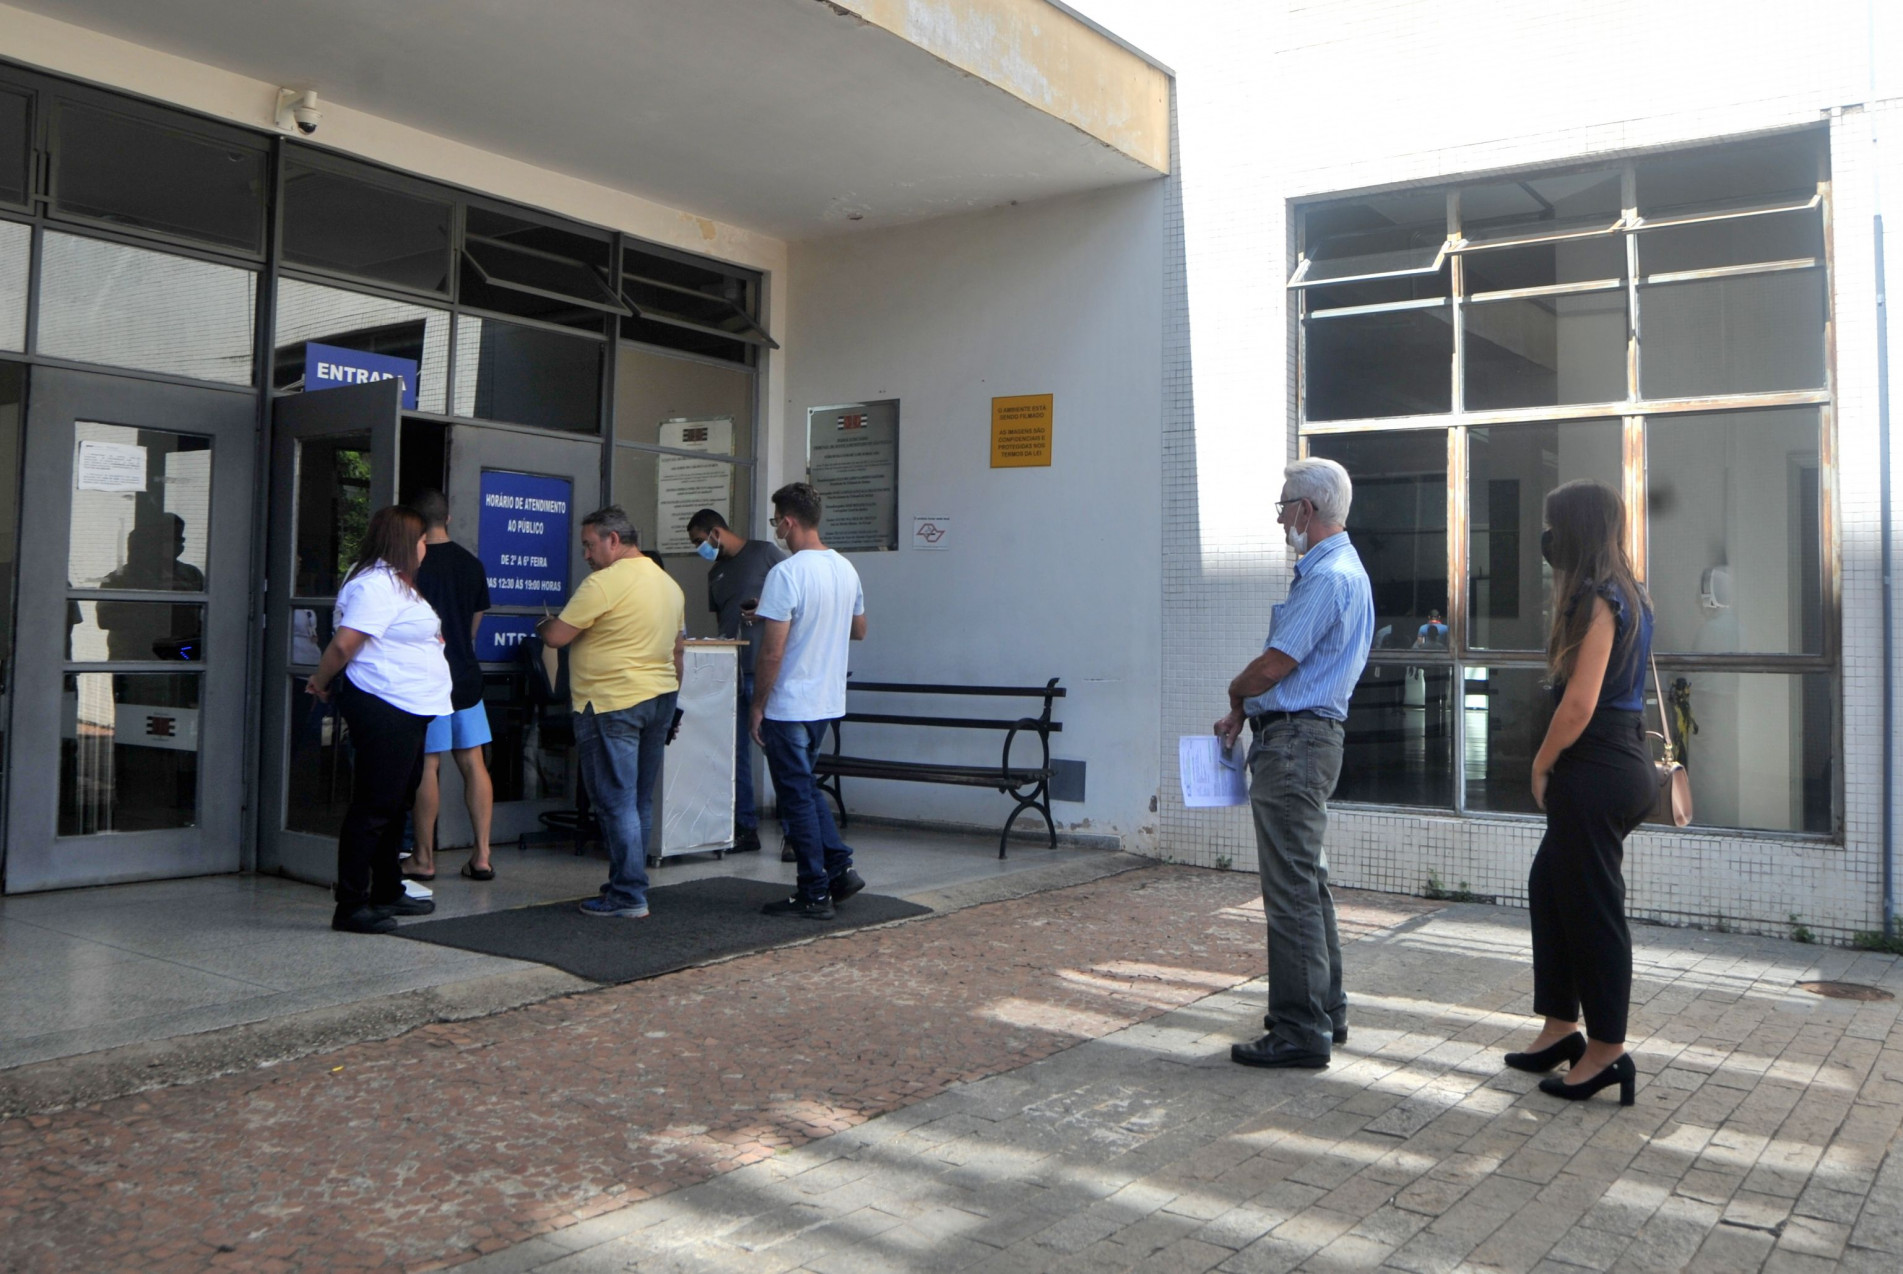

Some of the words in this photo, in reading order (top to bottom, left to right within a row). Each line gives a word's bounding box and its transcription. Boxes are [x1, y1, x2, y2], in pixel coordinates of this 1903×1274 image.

[486, 492, 513, 509] HORÁRIO
[515, 497, 524, 509] DE
[524, 498, 566, 514] ATENDIMENTO
[507, 520, 517, 532] AO
[518, 518, 544, 534] PÚBLICO
[501, 554, 510, 565] DE
[517, 556, 523, 566] A
[530, 557, 547, 567] FEIRA
[498, 578, 514, 589] 12:30
[525, 580, 540, 590] 19:00
[541, 581, 561, 591] HORAS
